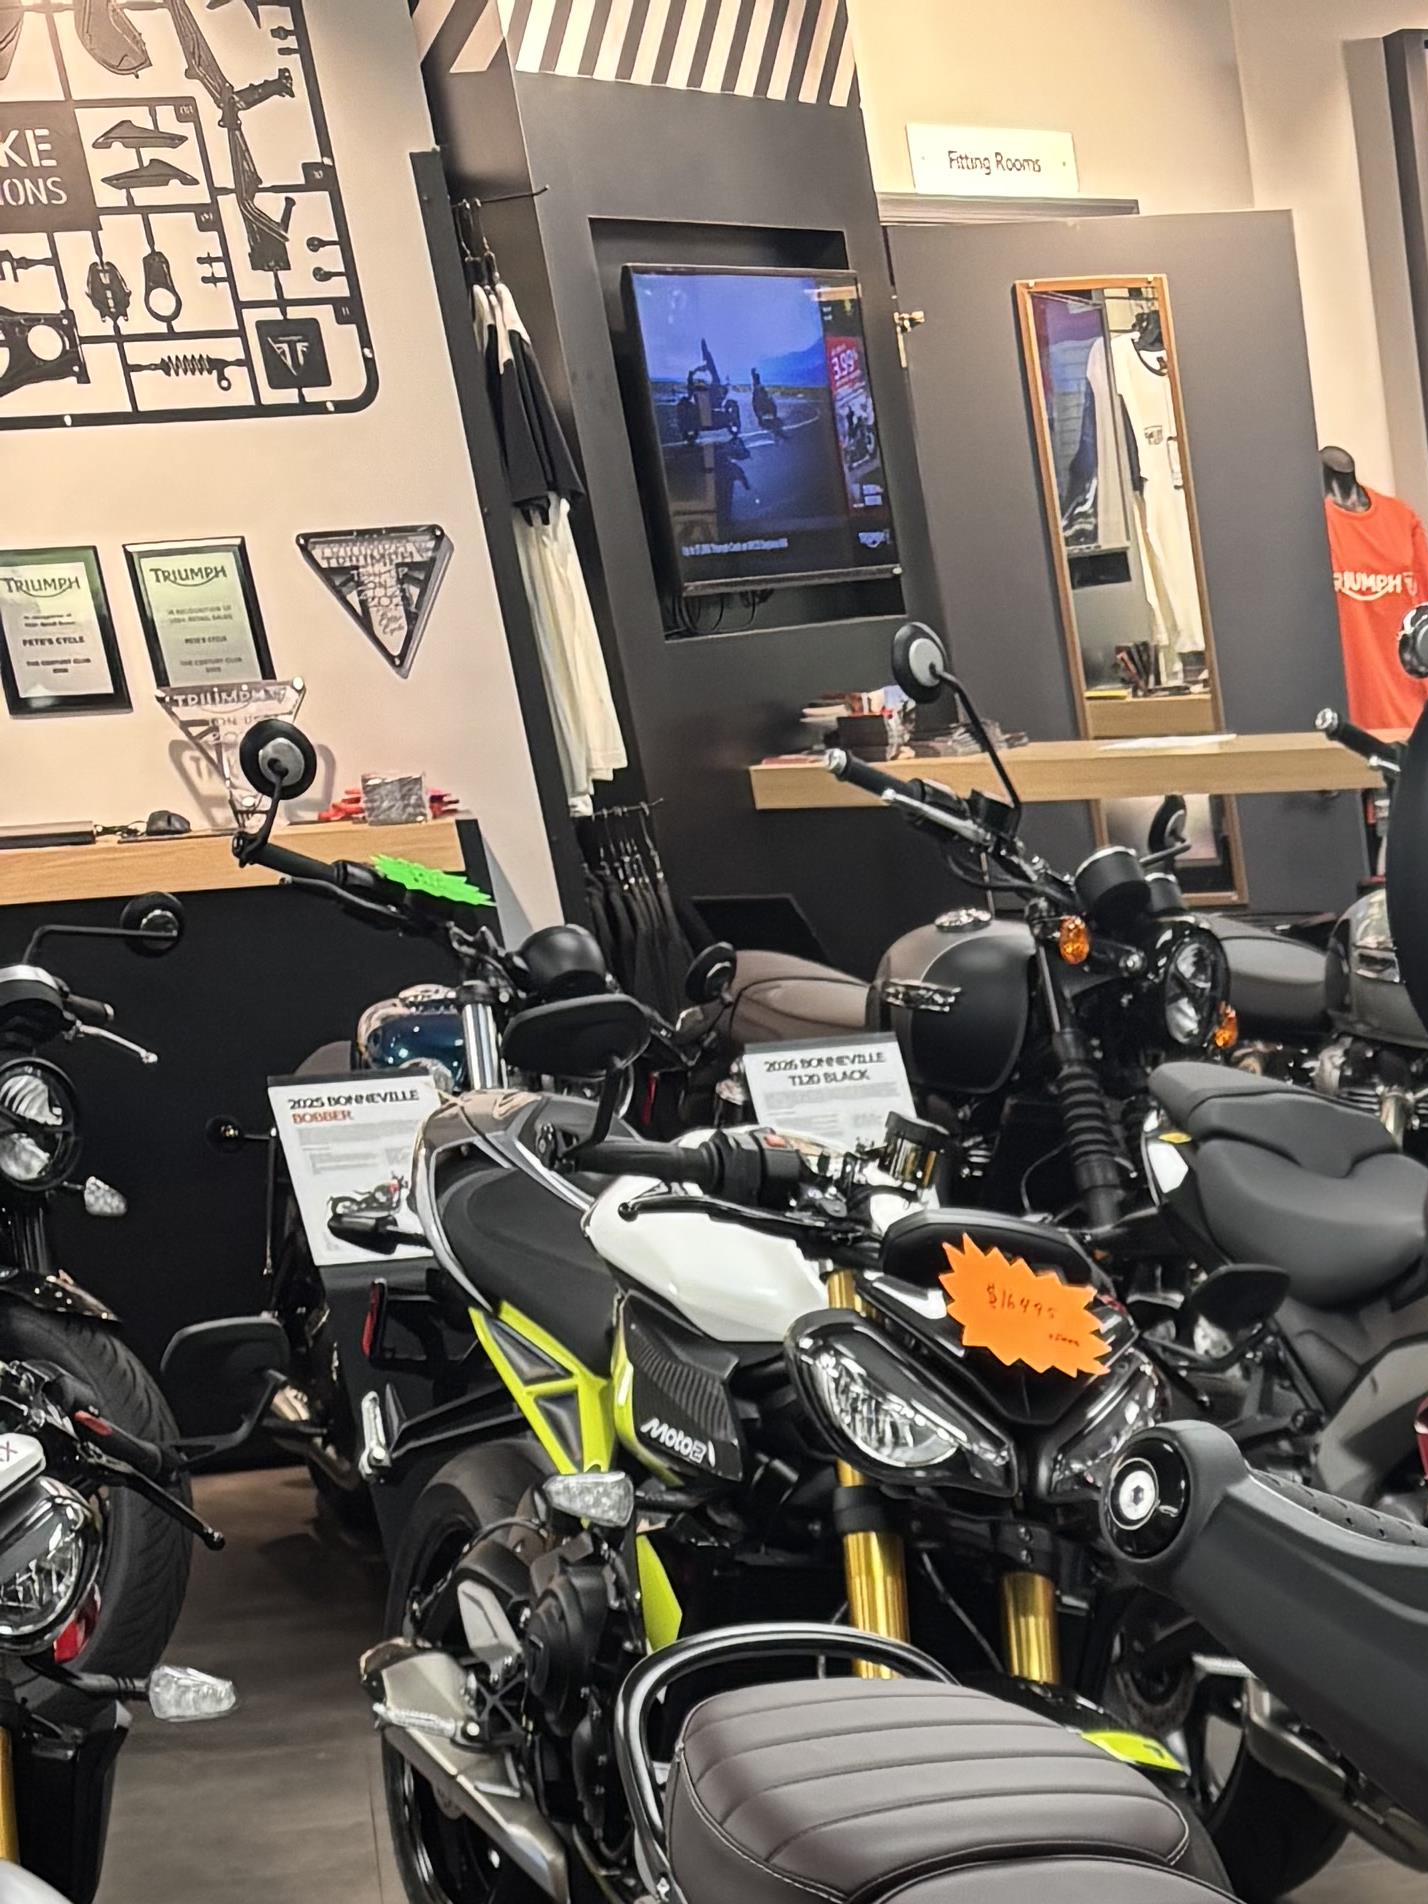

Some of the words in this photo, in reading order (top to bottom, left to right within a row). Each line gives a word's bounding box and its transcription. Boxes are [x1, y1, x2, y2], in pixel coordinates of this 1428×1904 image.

[948, 150, 991, 175] Fitting
[995, 152, 1041, 172] Rooms
[149, 565, 228, 587] TRIUMPH
[1333, 571, 1402, 601] RIUMPH
[0, 577, 81, 598] TRIUMPH
[800, 1052, 887, 1069] BONNEVILLE
[788, 1073, 821, 1086] T120
[823, 1069, 871, 1083] BLACK
[288, 1097, 325, 1109] 2025
[327, 1090, 420, 1107] BONNEVILLE
[292, 1110, 354, 1124] BOBBER
